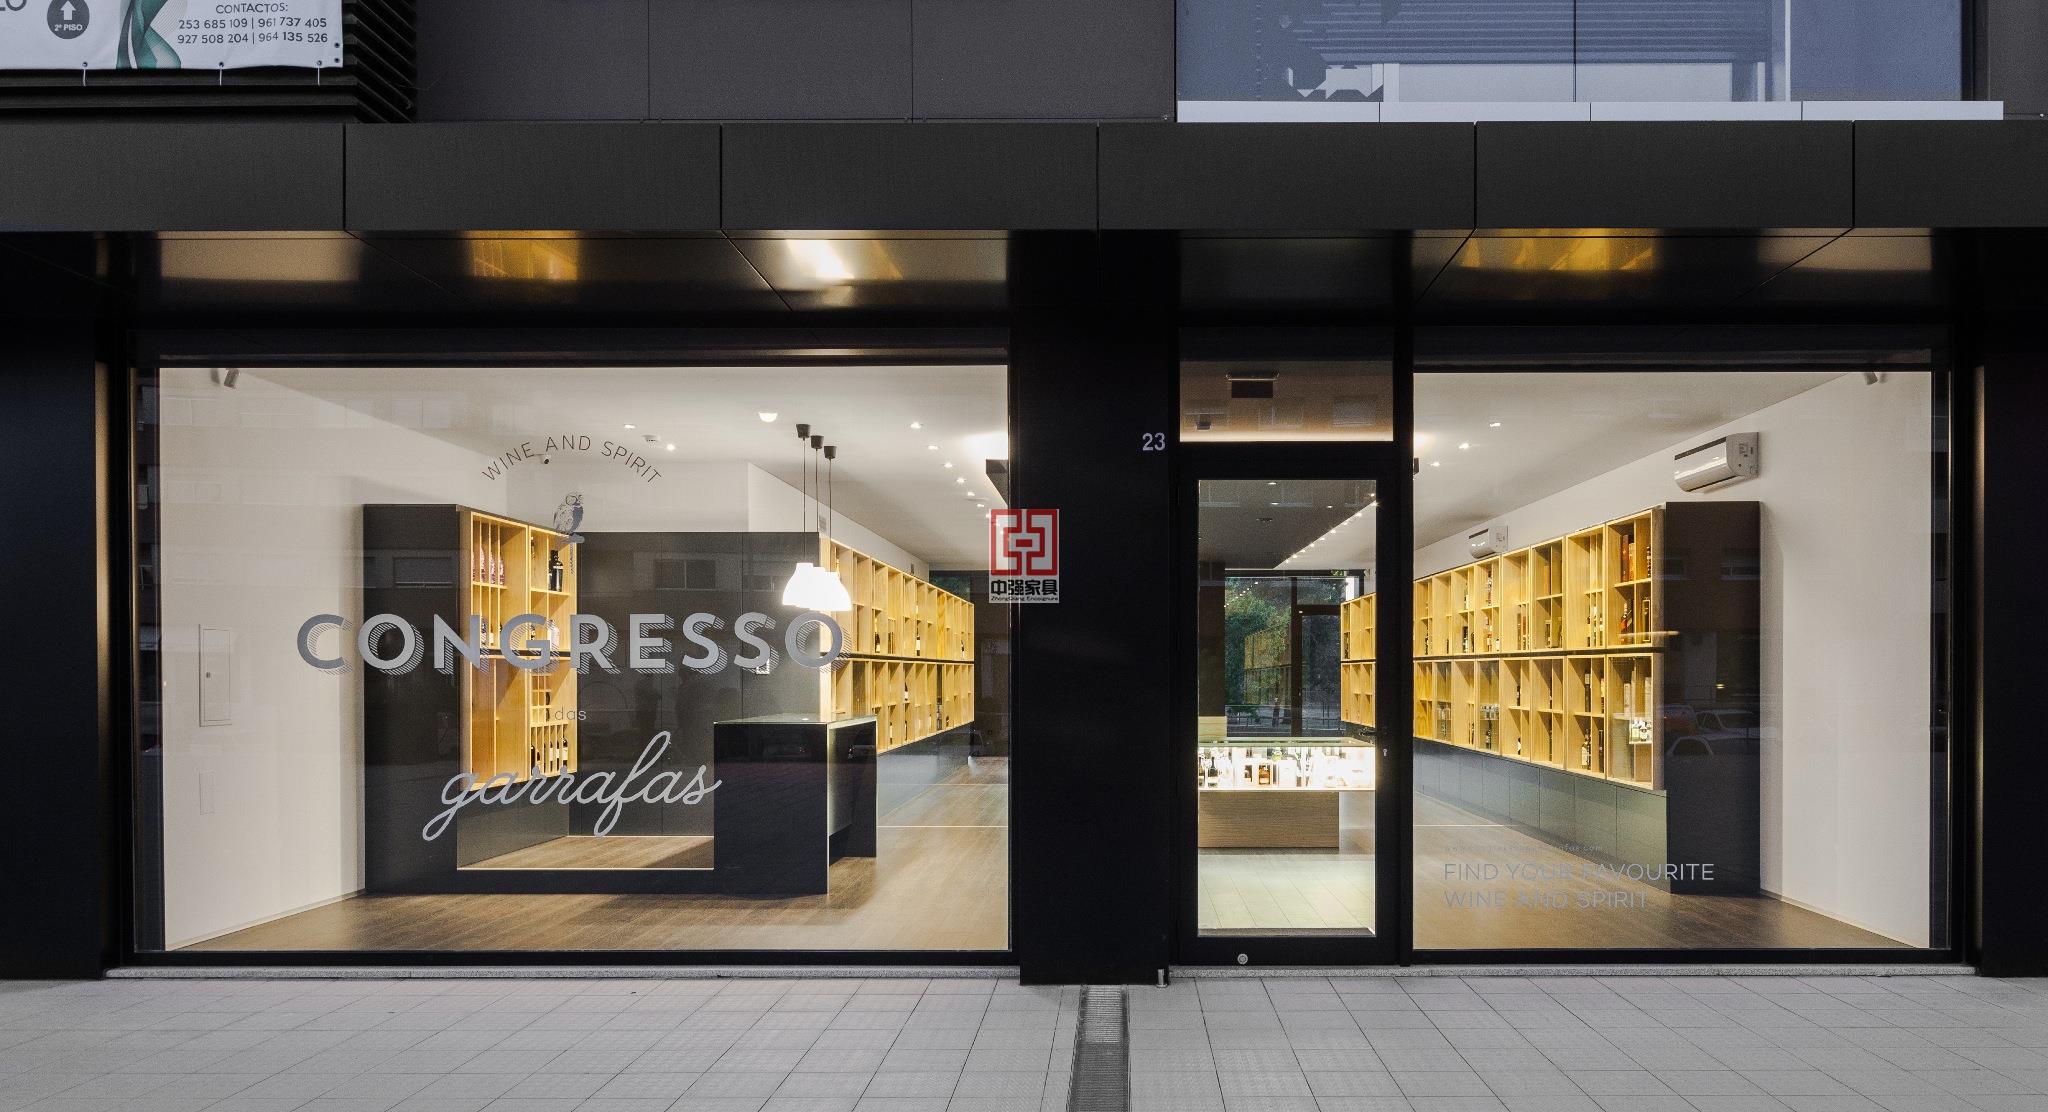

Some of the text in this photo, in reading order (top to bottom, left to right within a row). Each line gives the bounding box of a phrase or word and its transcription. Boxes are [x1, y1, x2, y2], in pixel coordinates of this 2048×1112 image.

[215, 2, 289, 14] CONTACTOS:
[178, 19, 200, 29] 253
[203, 19, 226, 29] 685
[229, 18, 248, 28] 109
[258, 17, 277, 28] 961
[279, 16, 301, 27] 737
[304, 17, 328, 28] 405
[177, 34, 198, 44] 927
[201, 34, 224, 44] 508
[227, 33, 249, 43] 204
[258, 31, 279, 42] 964
[282, 31, 303, 42] 135
[307, 32, 329, 43] 526
[1142, 432, 1166, 451] 23
[481, 434, 662, 483] WINE AND SPIRIT
[296, 611, 852, 676] CONGRESSO
[554, 706, 588, 721] das
[422, 731, 723, 842] garrafas
[1444, 863, 1715, 881] FIND YOUR FAVOURITE
[1444, 890, 1505, 908] WINE
[1576, 890, 1648, 909] SPIRIT
